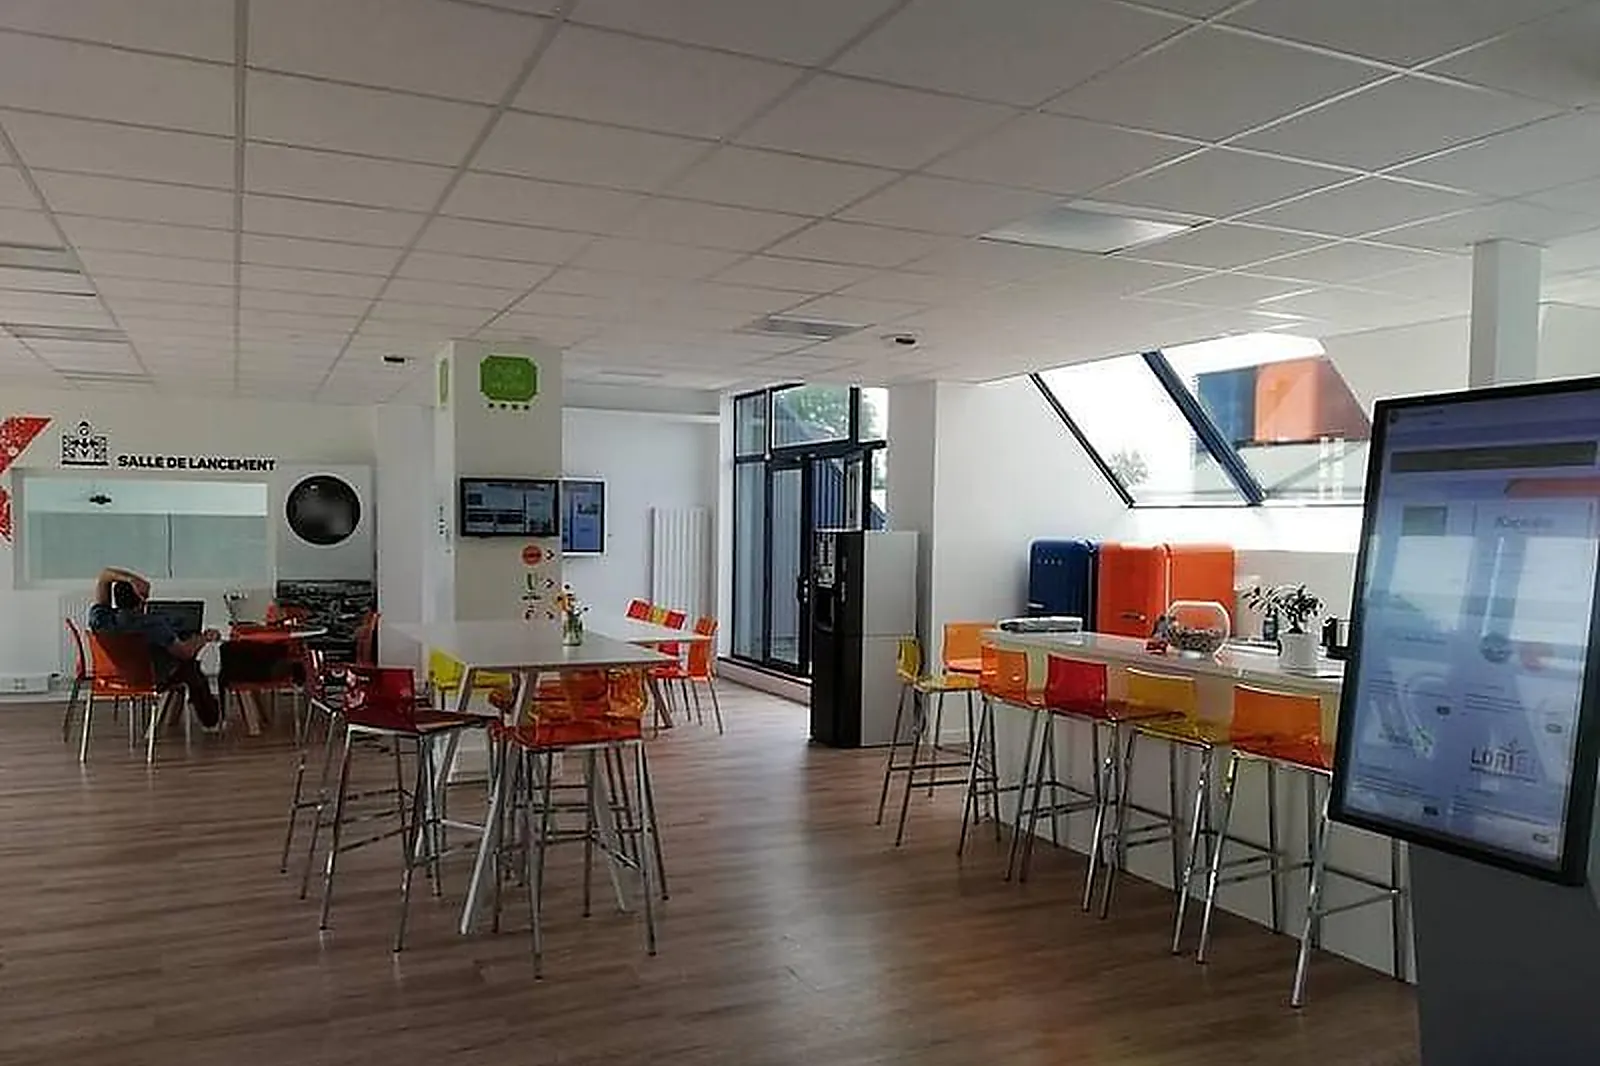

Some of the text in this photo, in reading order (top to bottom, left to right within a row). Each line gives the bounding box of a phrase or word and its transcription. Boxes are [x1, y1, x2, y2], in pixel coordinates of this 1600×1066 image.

[118, 455, 276, 472] SALLE DE LANCEMENT
